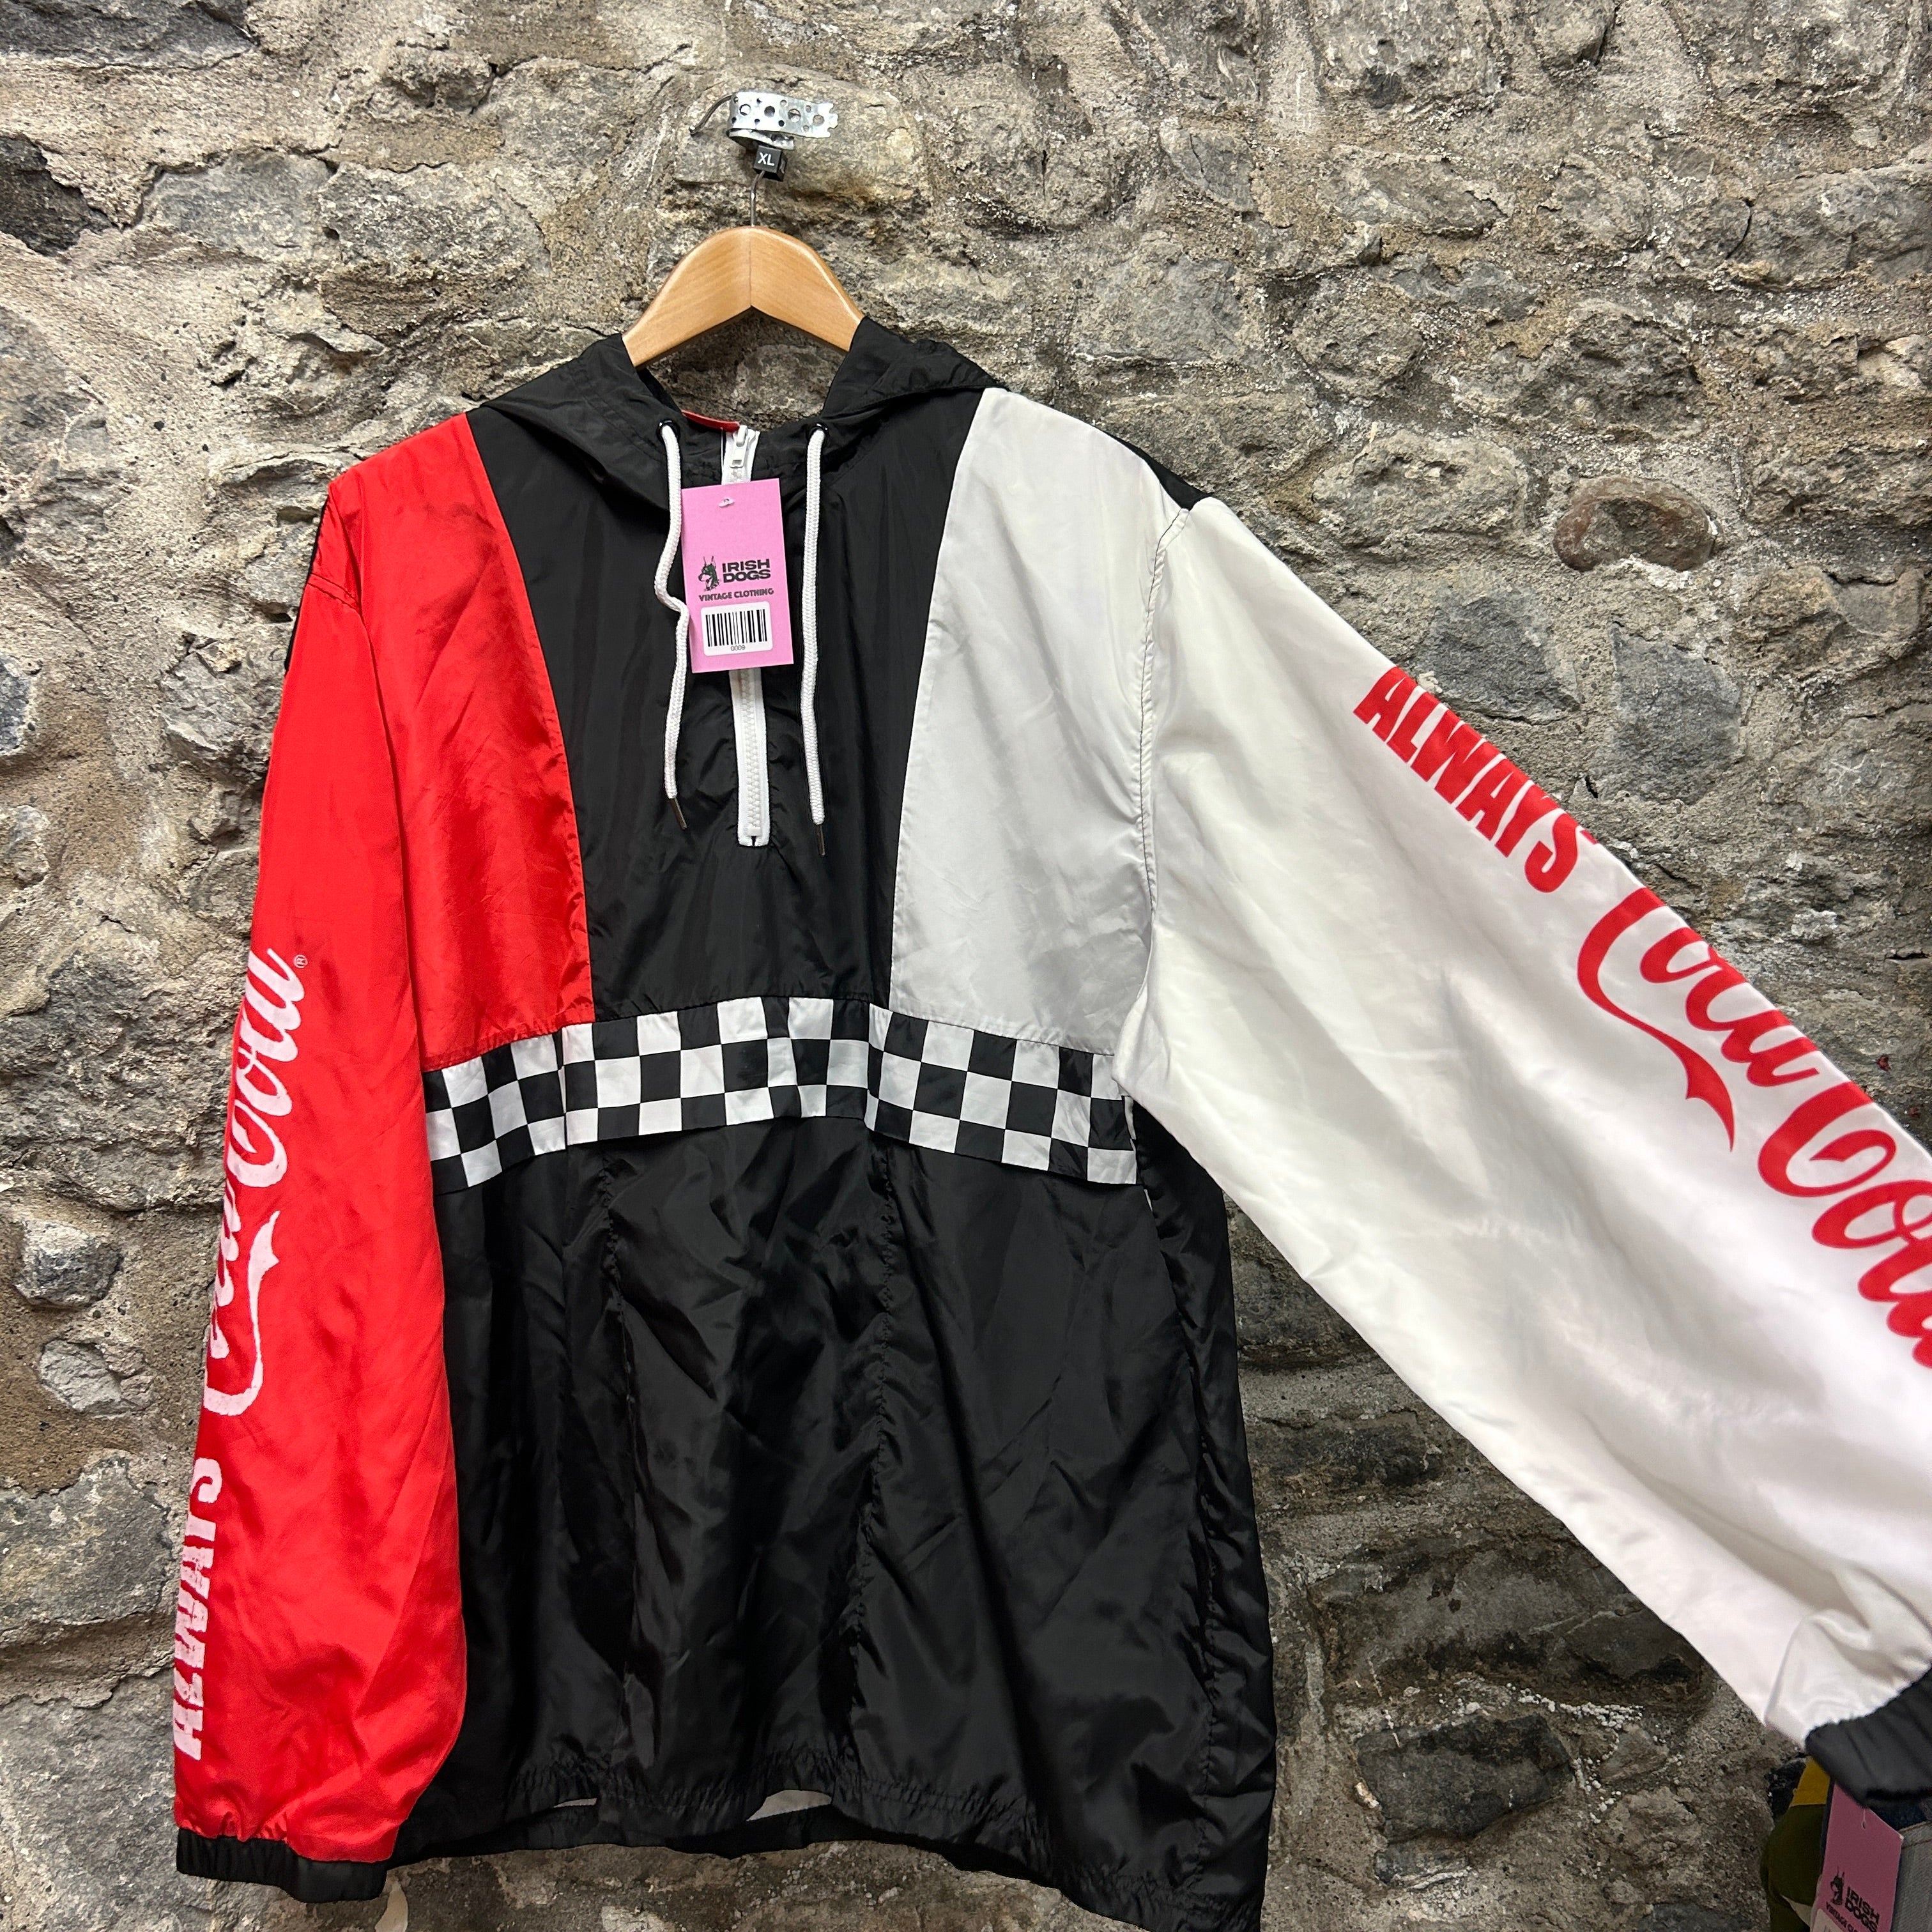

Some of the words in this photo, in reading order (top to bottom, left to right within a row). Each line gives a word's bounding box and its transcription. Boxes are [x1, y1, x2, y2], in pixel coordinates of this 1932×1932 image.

[757, 152, 775, 167] XL
[722, 558, 770, 573] IRISH
[723, 569, 771, 583] DOGS
[698, 591, 732, 602] VINTAGE
[734, 587, 774, 599] CLOTHING
[1354, 666, 1597, 893] ALWAYS
[1847, 1887, 1880, 1926] IRISH
[1845, 1897, 1878, 1932] DOGS
